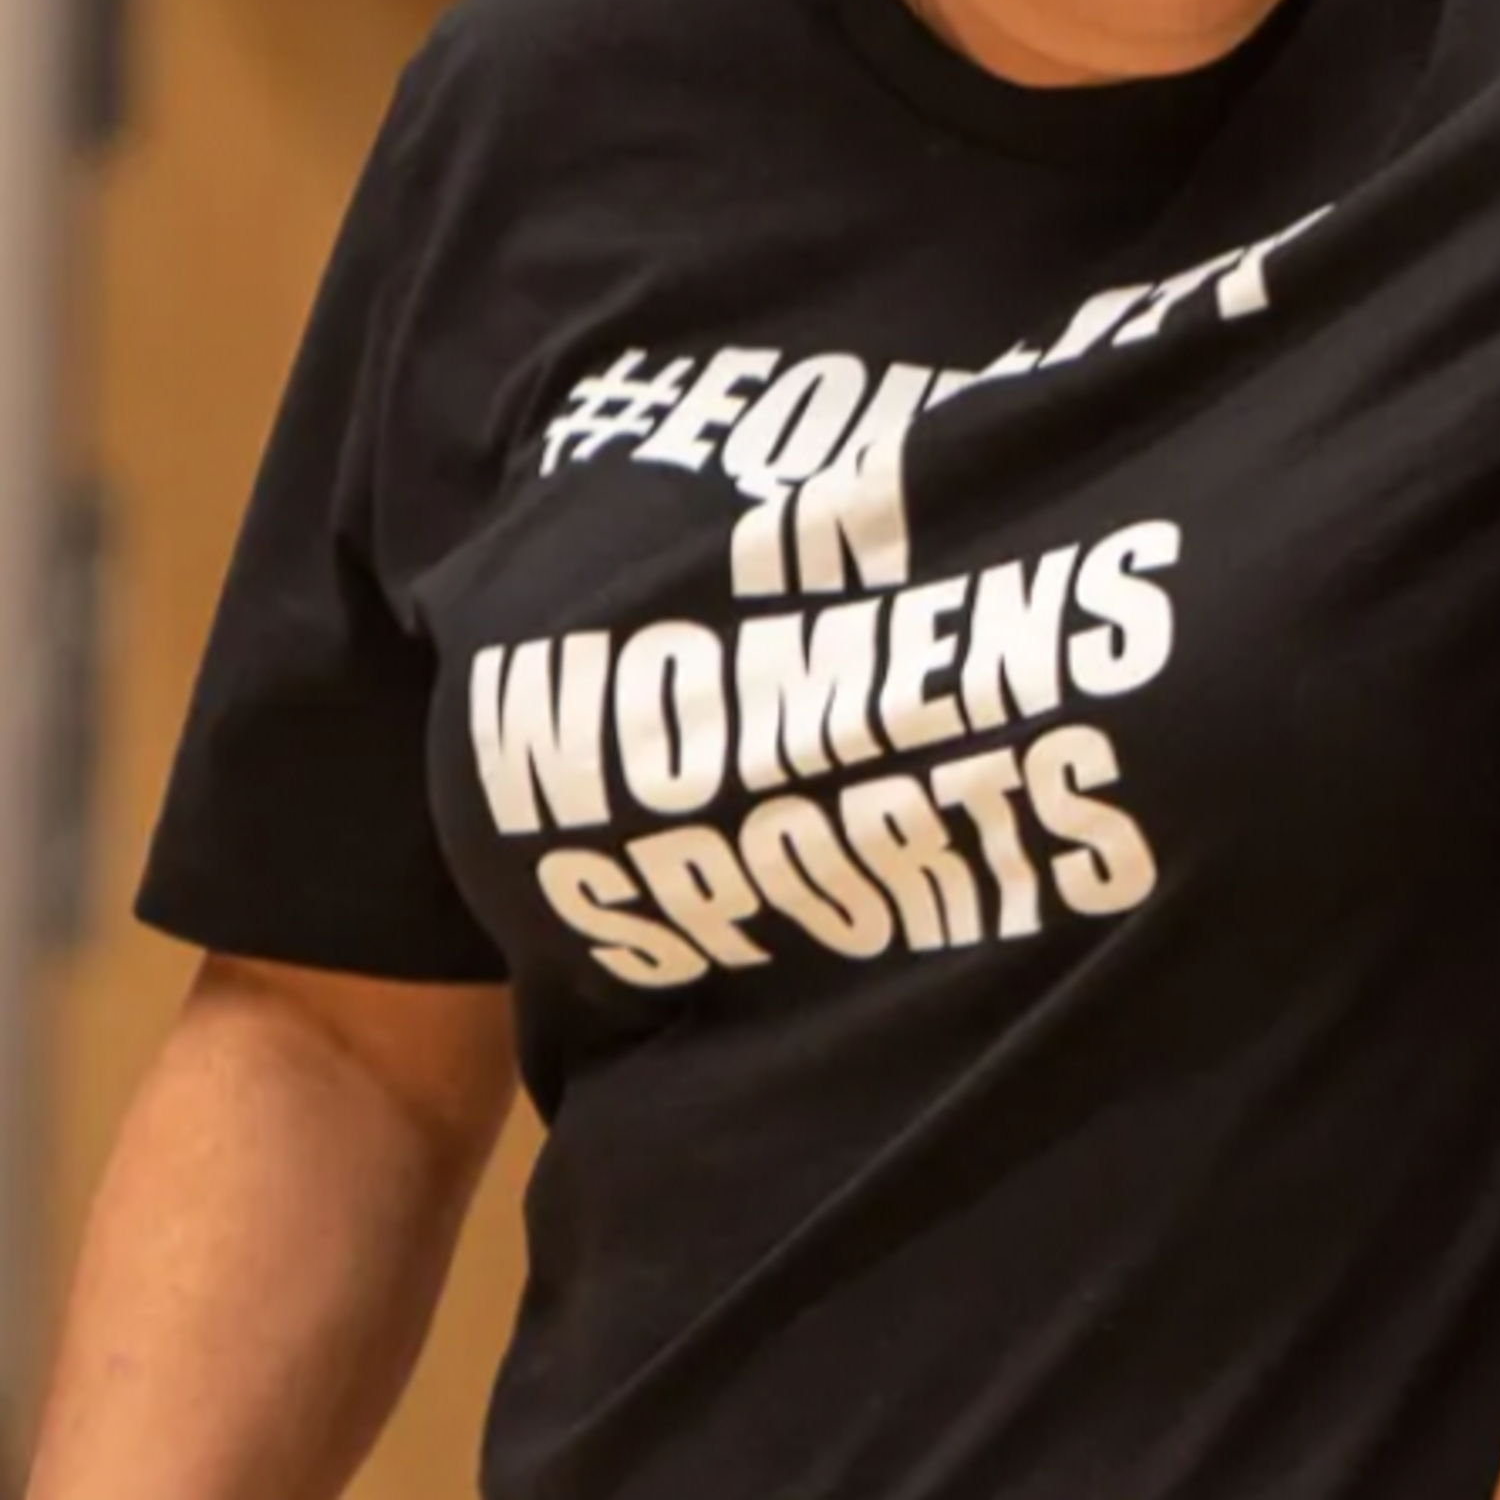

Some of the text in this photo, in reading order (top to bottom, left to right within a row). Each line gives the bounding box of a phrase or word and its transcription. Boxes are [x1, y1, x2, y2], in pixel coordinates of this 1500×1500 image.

[538, 204, 1334, 500] #EQITY
[731, 445, 911, 598] IN
[468, 518, 1182, 836] WOMENS
[536, 724, 1157, 988] SPORTS
